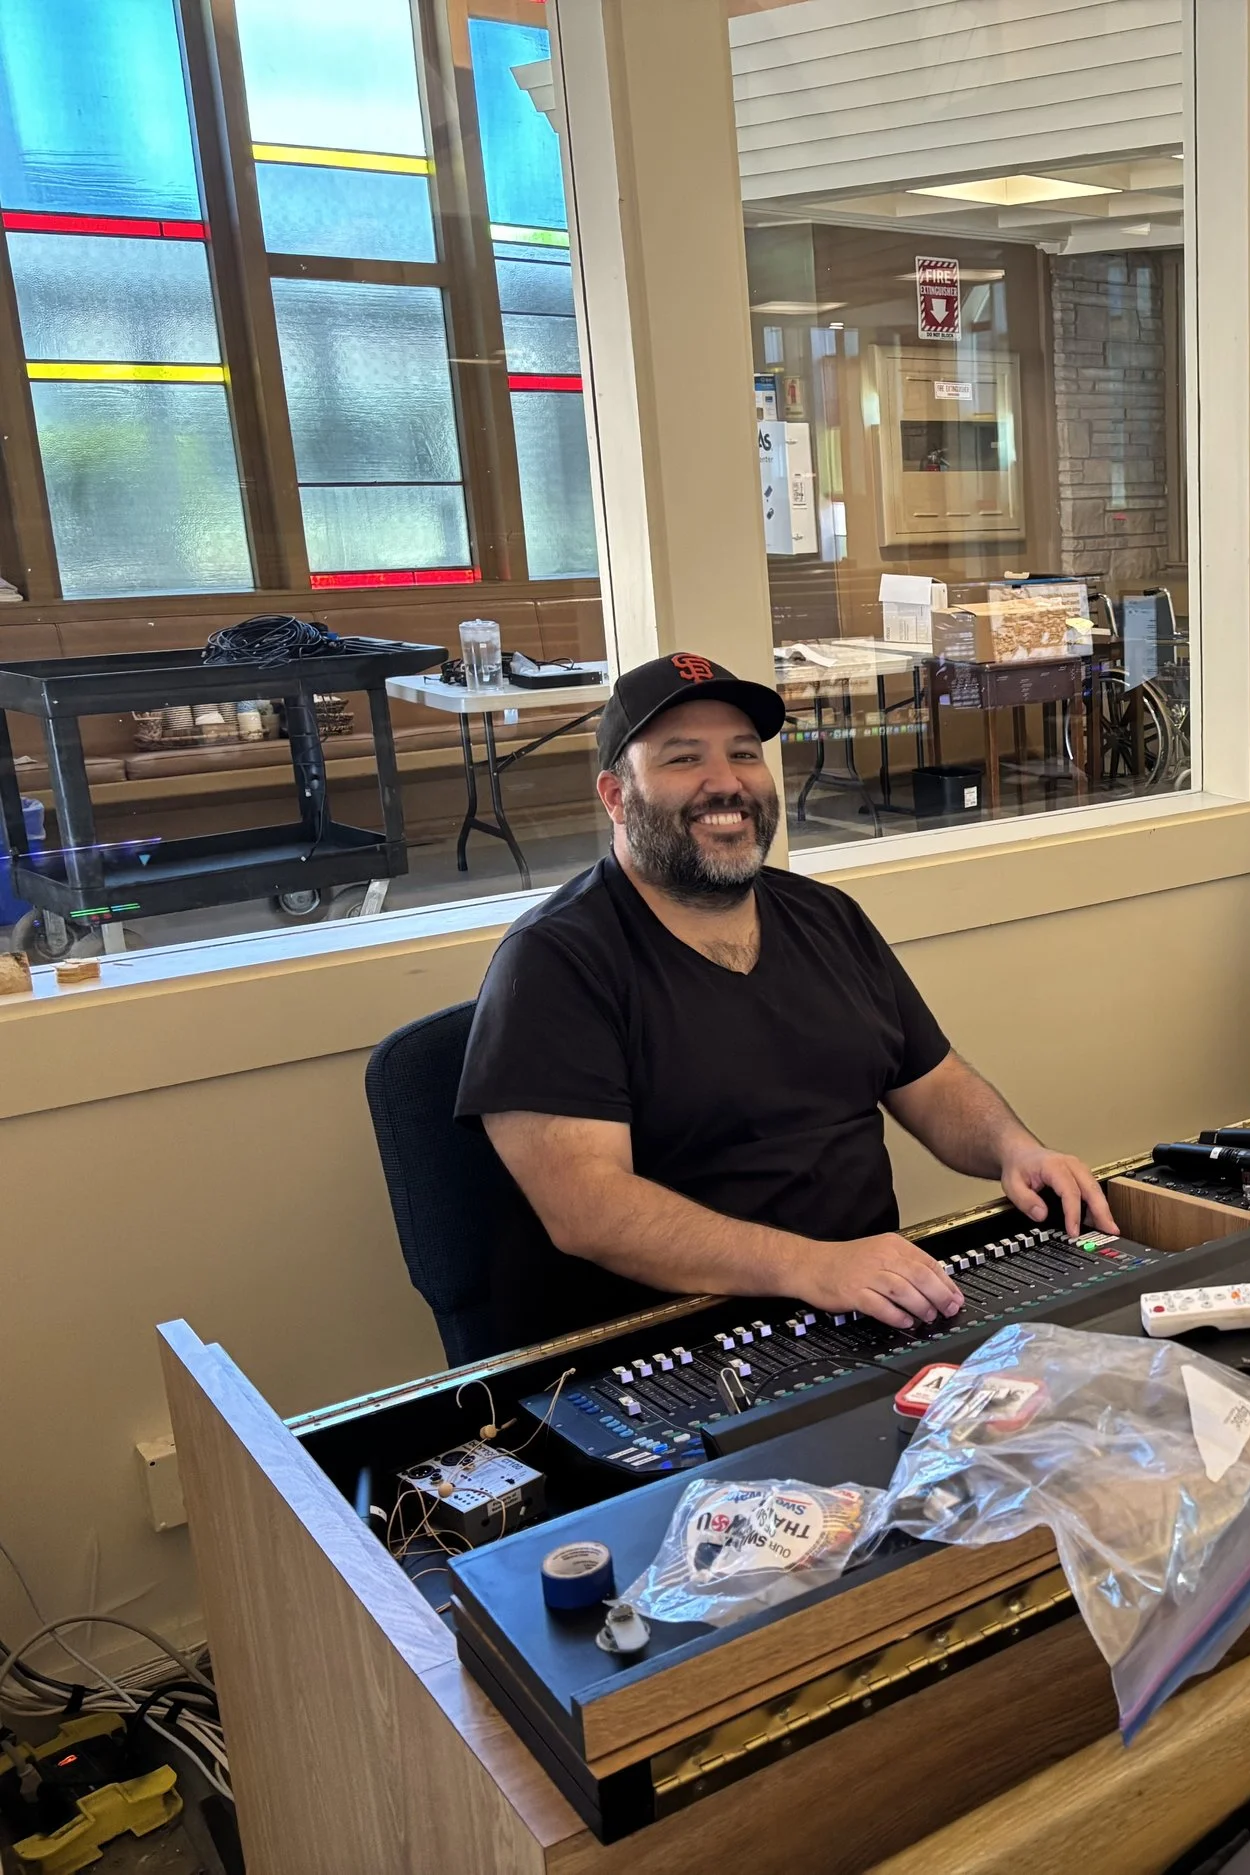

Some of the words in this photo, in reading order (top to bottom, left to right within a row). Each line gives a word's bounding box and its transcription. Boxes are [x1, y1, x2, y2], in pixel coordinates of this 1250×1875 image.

[925, 268, 951, 284] FIRE
[920, 285, 957, 296] EXTINGUISHER
[768, 1541, 792, 1559] OUR
